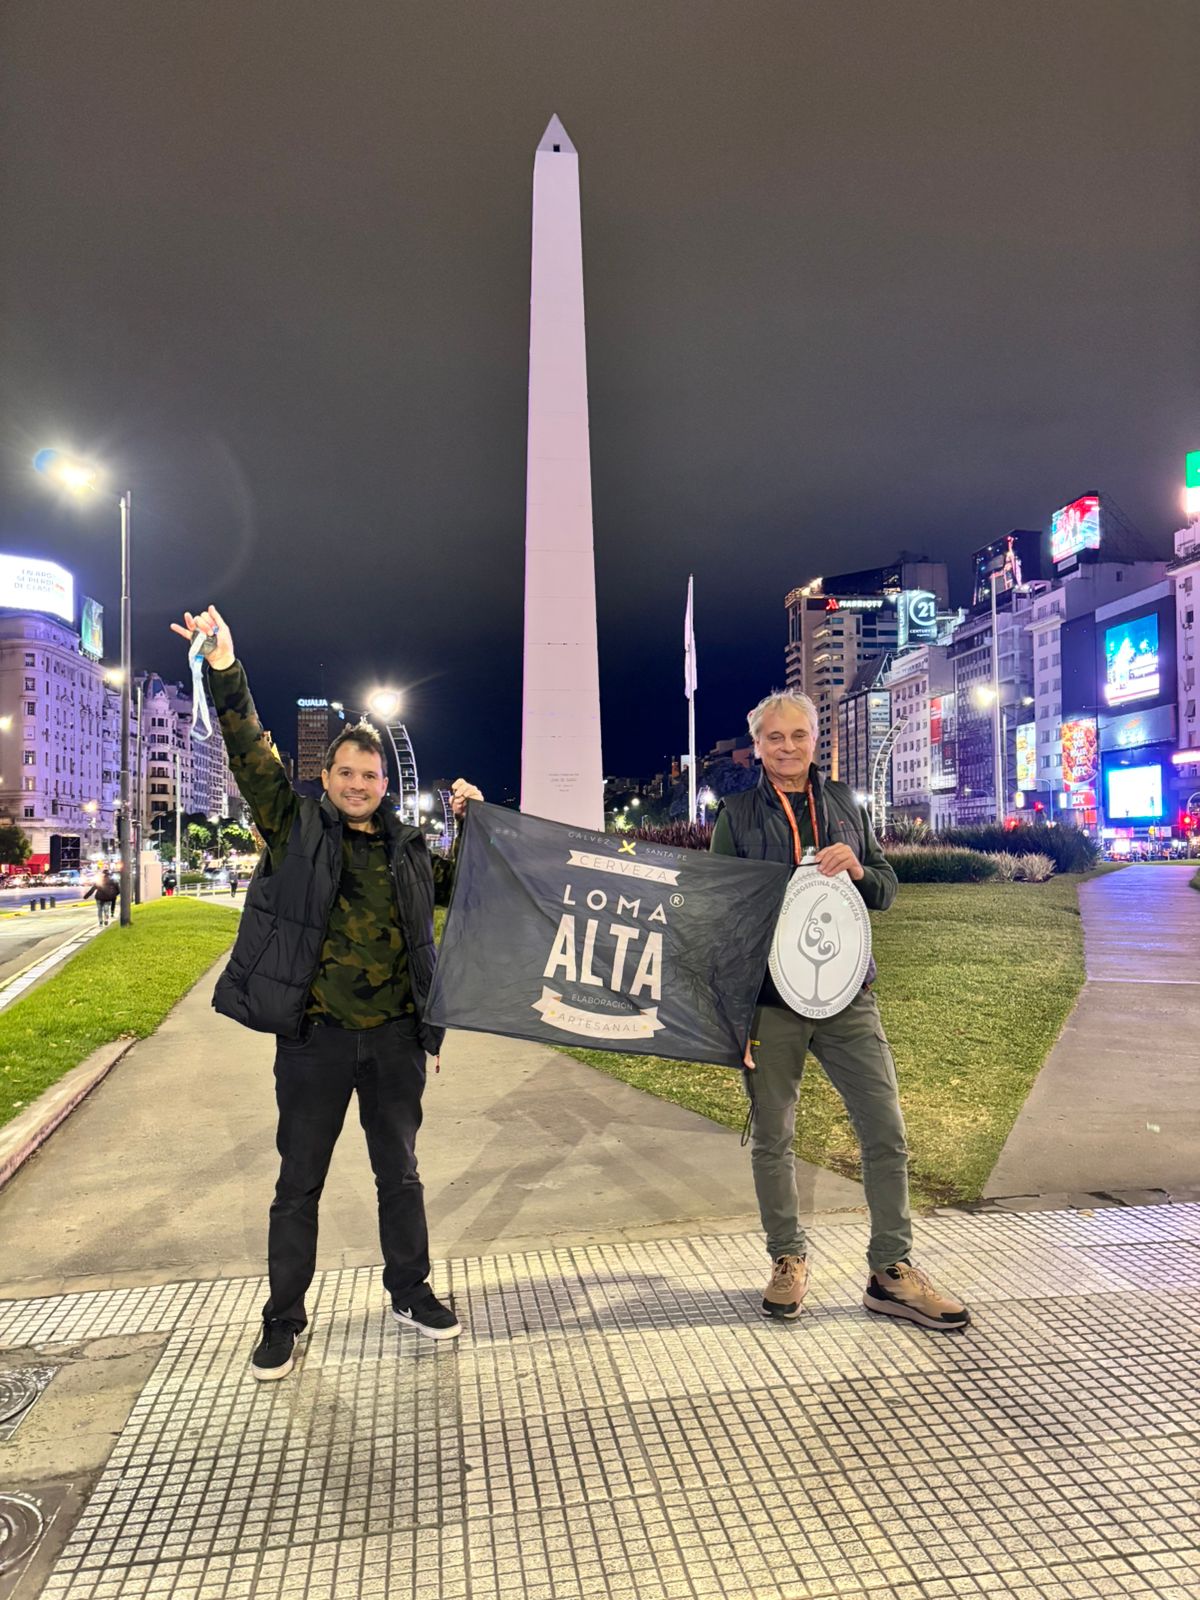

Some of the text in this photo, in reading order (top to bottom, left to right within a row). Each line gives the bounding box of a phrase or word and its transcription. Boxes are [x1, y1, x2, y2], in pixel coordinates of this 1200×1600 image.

[838, 600, 883, 608] MARRIOTT
[297, 698, 328, 707] QUALIA
[646, 848, 688, 862] SANTA FE
[579, 855, 668, 881] CERVEZA
[563, 884, 668, 924] LOMA
[781, 880, 861, 921] COPA ARGENTINA DE CERVEZAS
[543, 914, 663, 1001] ALTA
[802, 1006, 828, 1017] 2026
[558, 1012, 639, 1033] ARTESANAL
